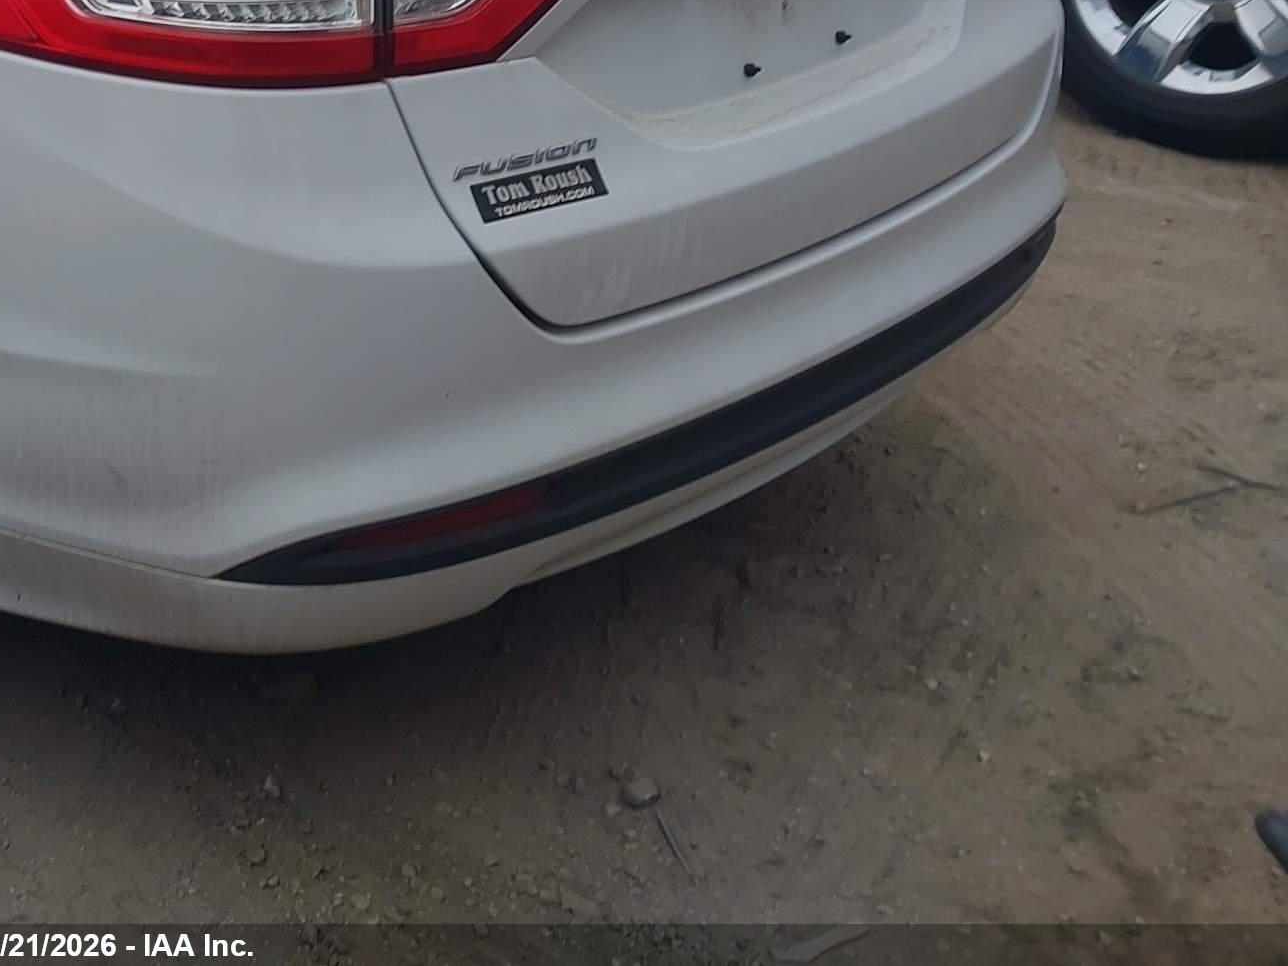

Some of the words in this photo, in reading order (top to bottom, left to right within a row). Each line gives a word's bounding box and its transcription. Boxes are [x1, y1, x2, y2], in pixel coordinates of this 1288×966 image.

[453, 137, 598, 181] FUSION
[480, 181, 530, 205] Tom
[528, 163, 593, 194] Roush
[494, 185, 595, 217] TOMROUSH.COM
